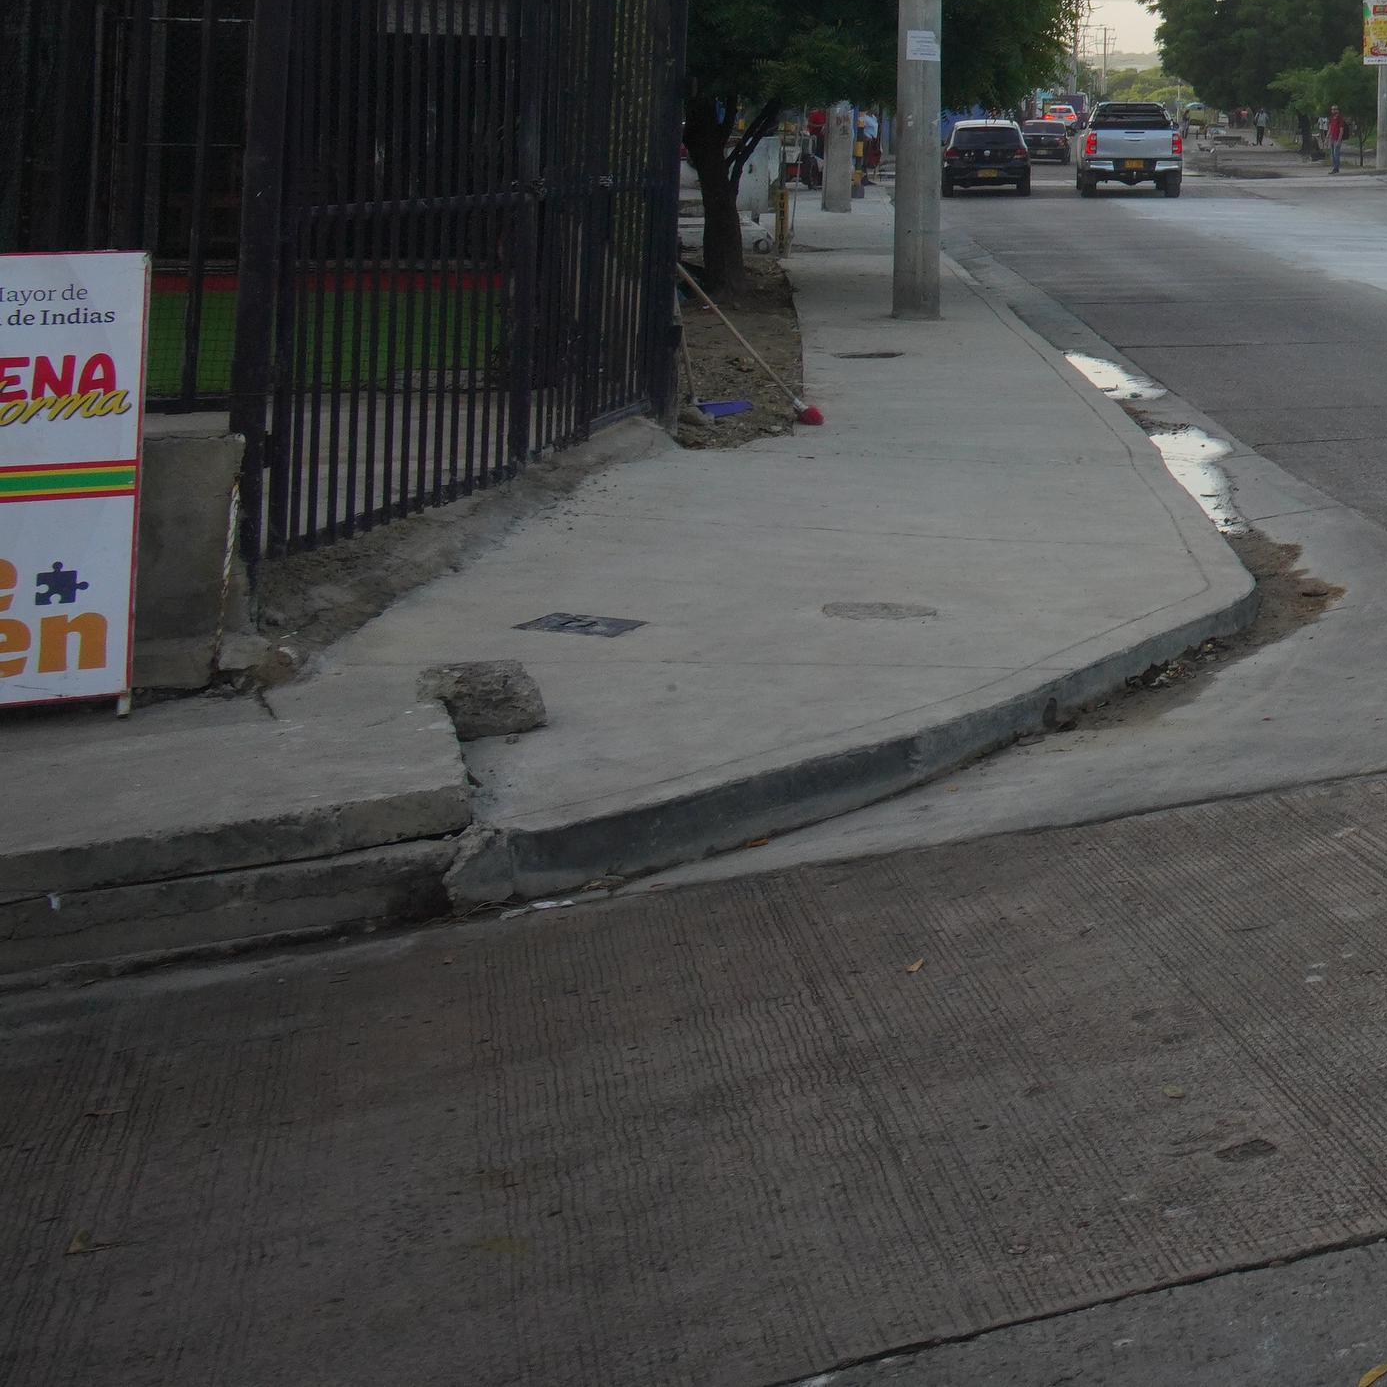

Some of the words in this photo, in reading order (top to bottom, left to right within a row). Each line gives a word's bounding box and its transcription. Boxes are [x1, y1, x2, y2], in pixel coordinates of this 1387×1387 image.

[61, 283, 88, 301] de
[7, 309, 36, 326] de
[40, 307, 116, 326] Indias
[0, 381, 133, 427] orma
